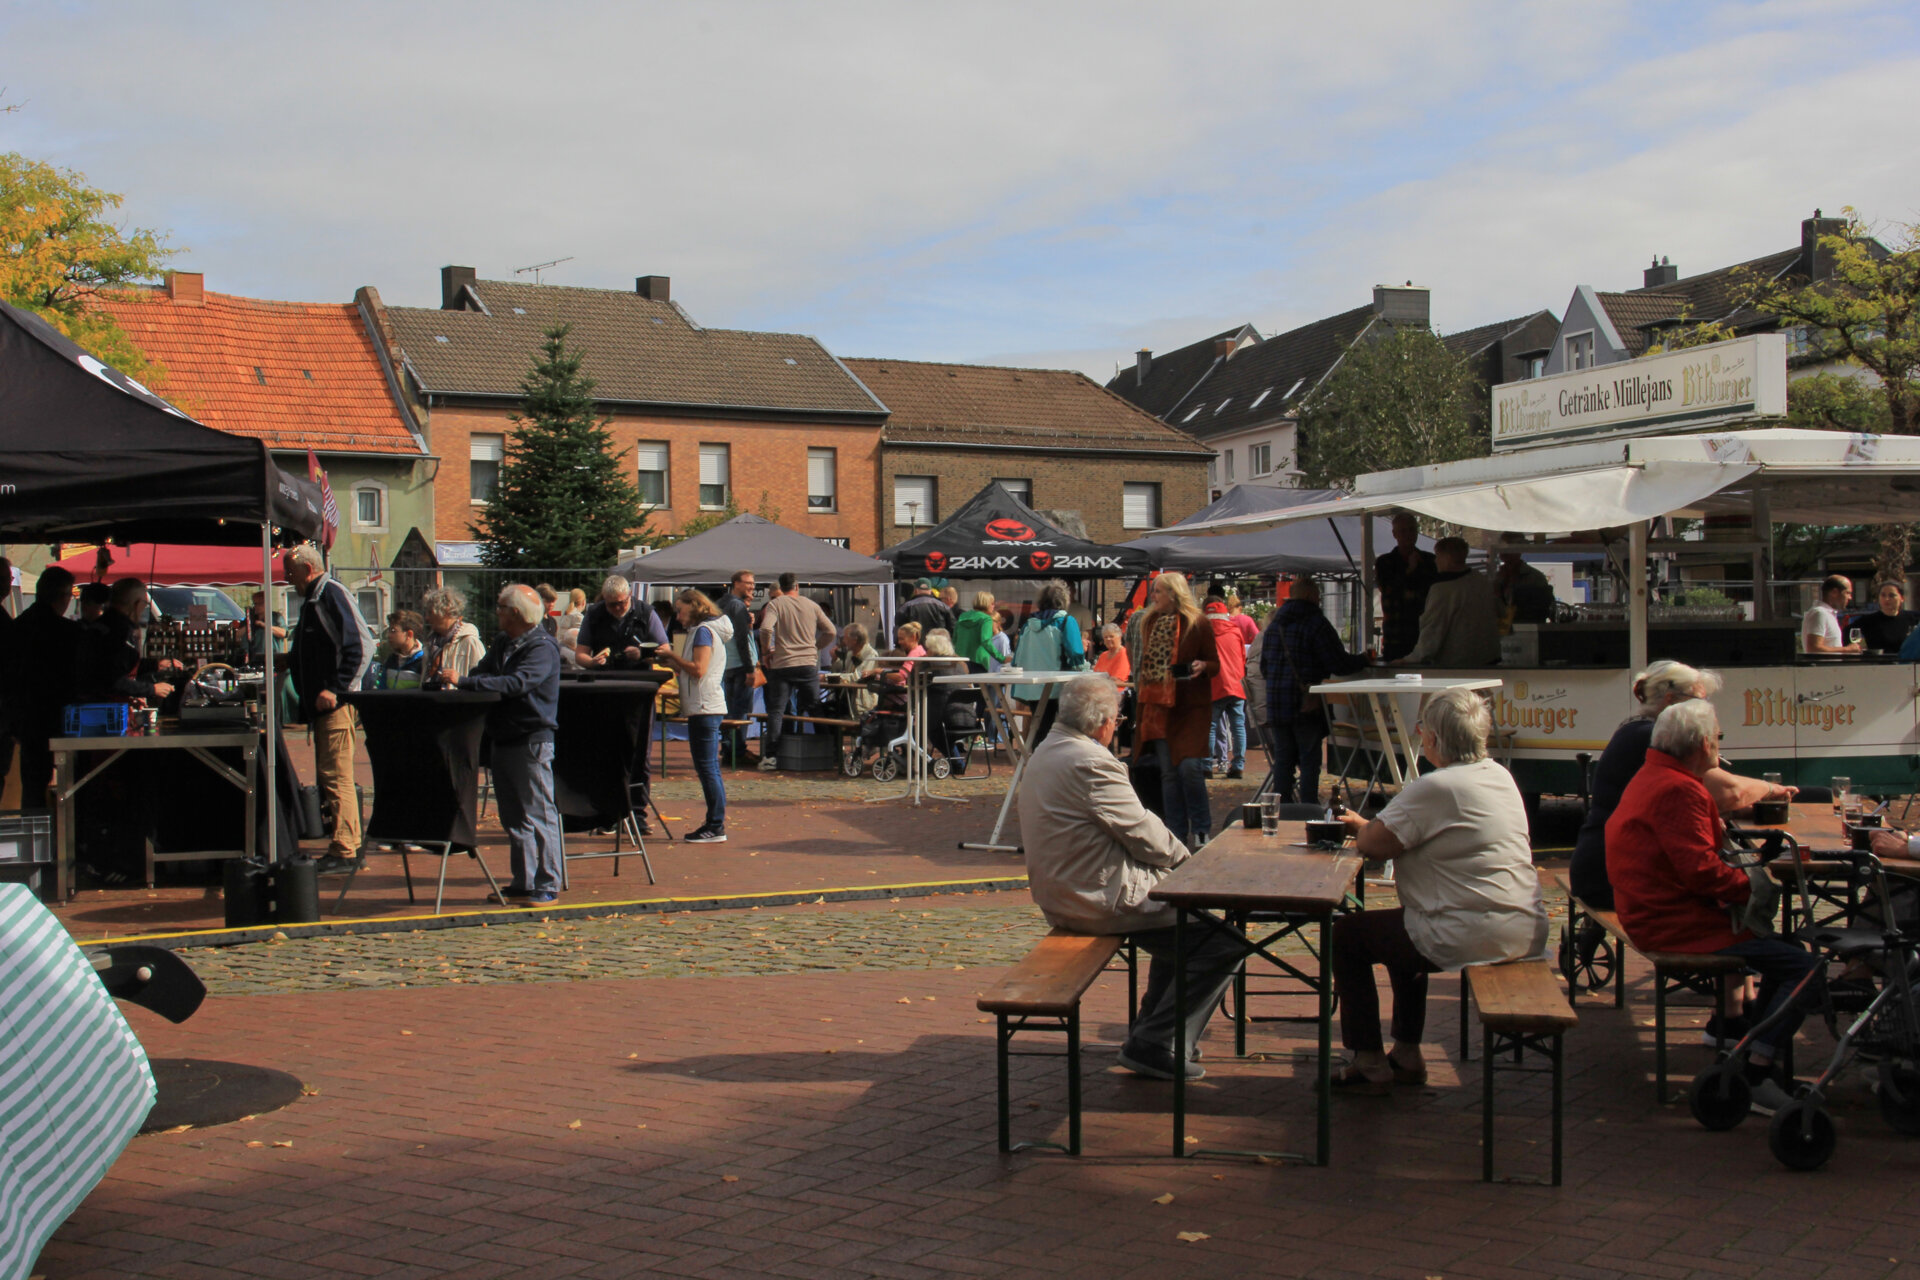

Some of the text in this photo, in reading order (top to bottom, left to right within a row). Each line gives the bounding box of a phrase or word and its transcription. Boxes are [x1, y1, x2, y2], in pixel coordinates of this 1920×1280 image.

[1558, 384, 1610, 417] Getränke
[1613, 374, 1672, 412] Müllejans
[1681, 362, 1751, 407] Bitburger
[1498, 397, 1551, 434] Bitburger
[949, 555, 1020, 570] 24MX
[1053, 555, 1123, 570] 24MX
[1495, 689, 1578, 734] tburger
[1742, 687, 1856, 732] Bitburger
